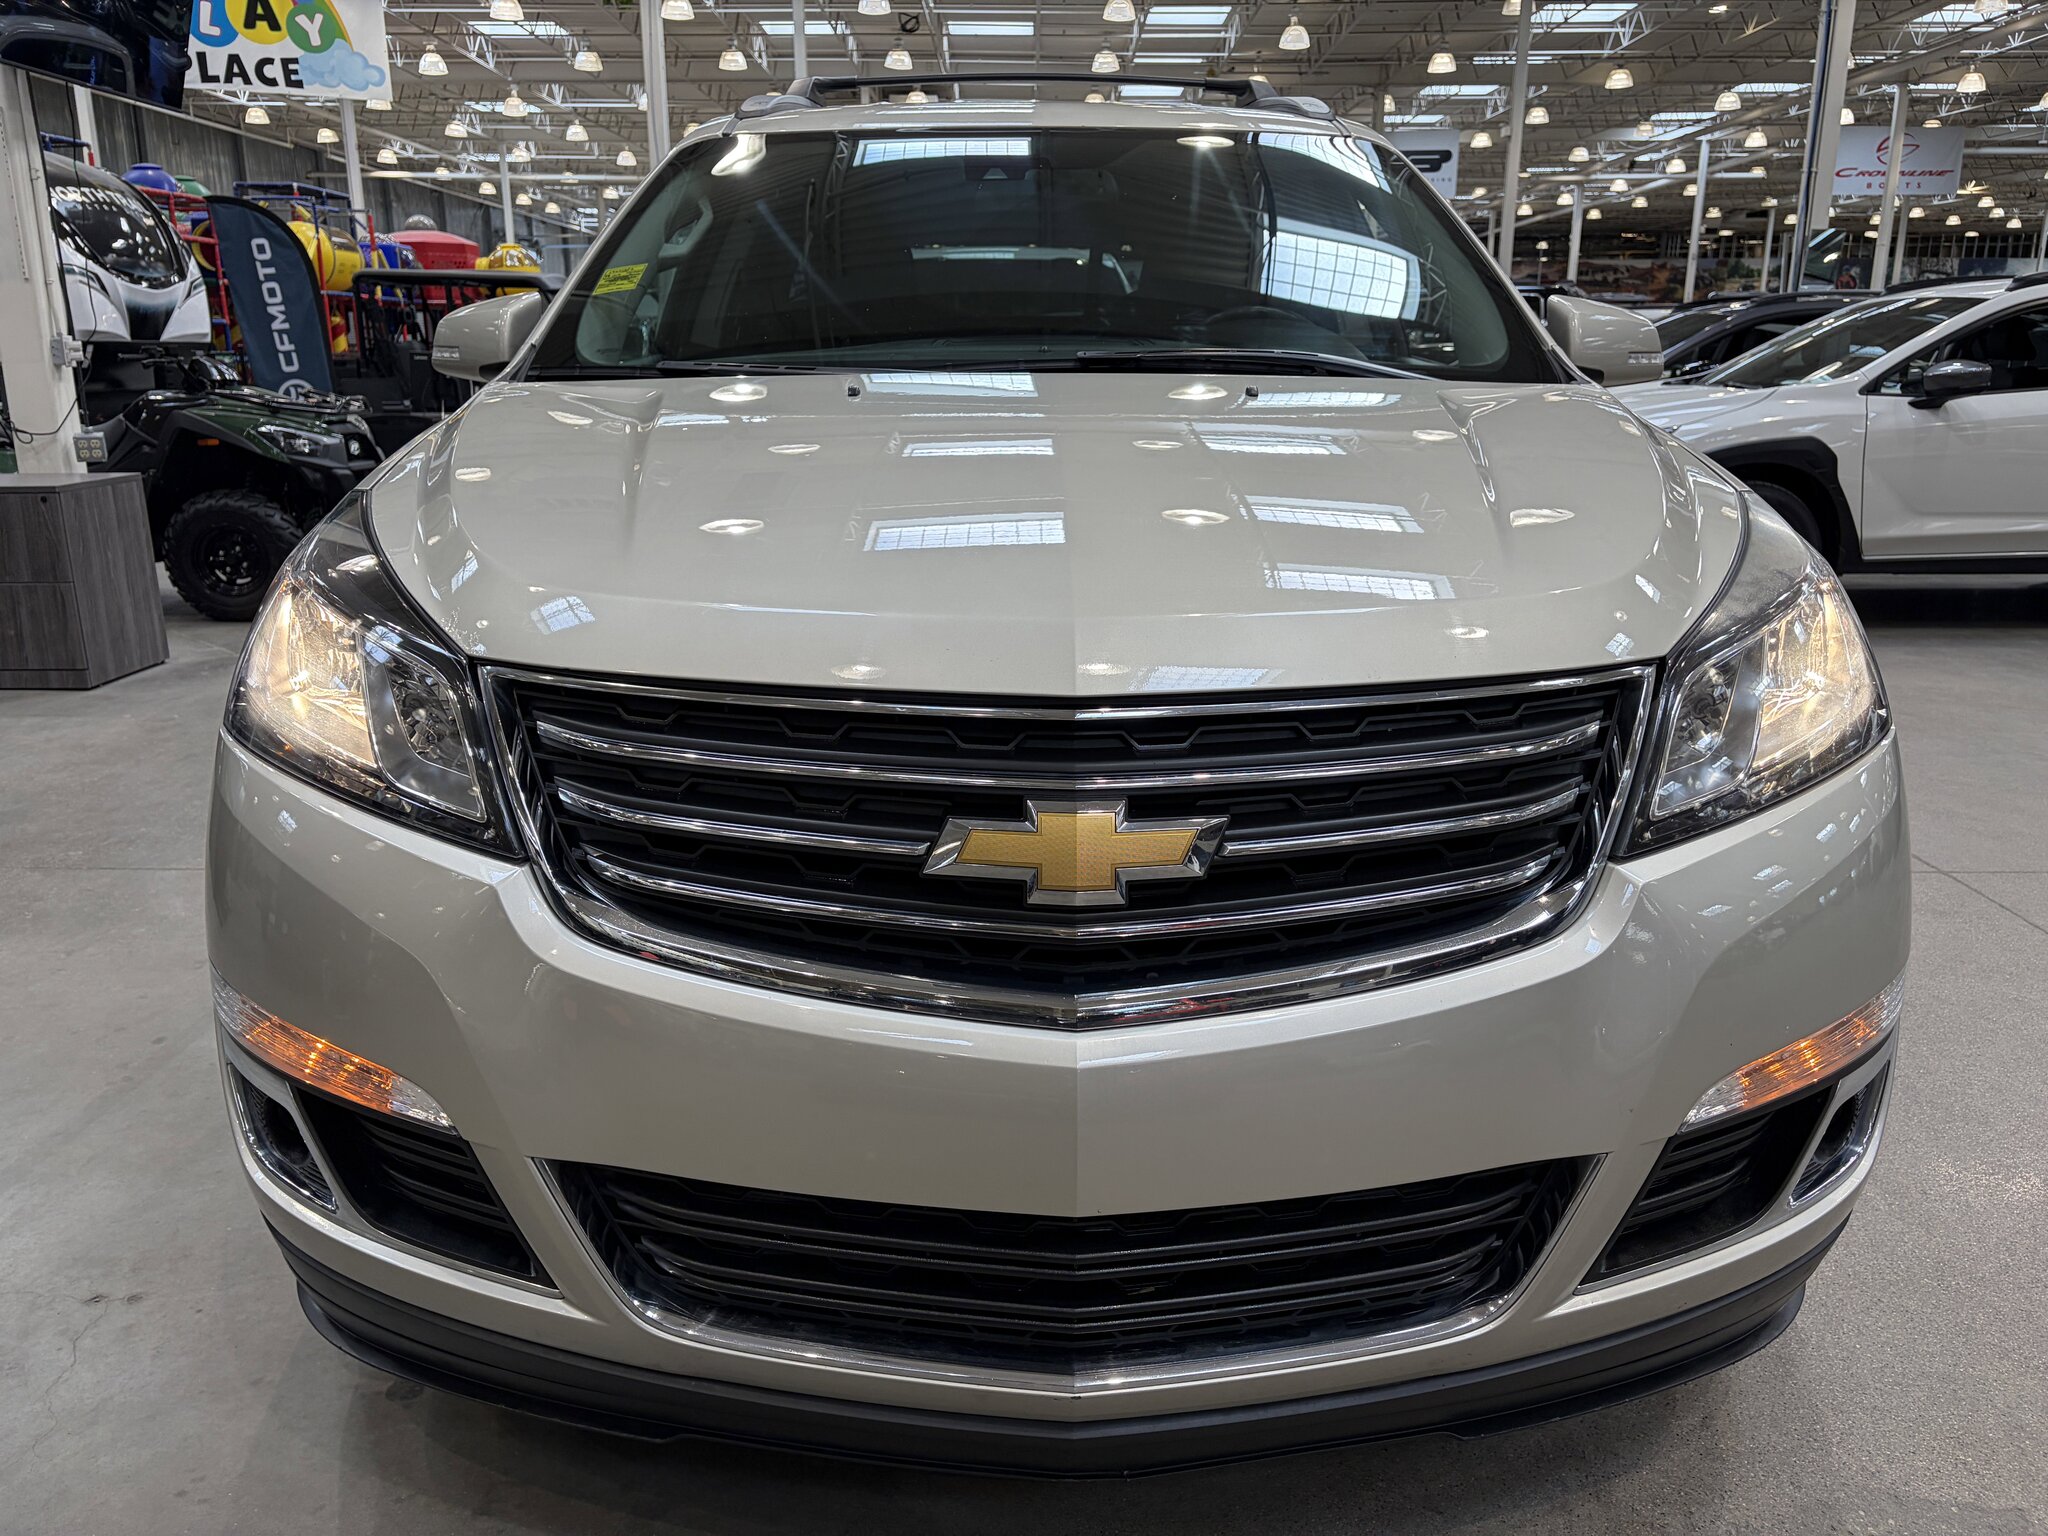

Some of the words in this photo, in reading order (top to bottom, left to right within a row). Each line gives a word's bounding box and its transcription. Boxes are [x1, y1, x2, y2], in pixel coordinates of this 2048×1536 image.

[199, 0, 323, 47] LAY
[196, 52, 304, 89] LACE
[1835, 167, 1955, 177] CRONLINE
[251, 237, 299, 373] CFMOTO
